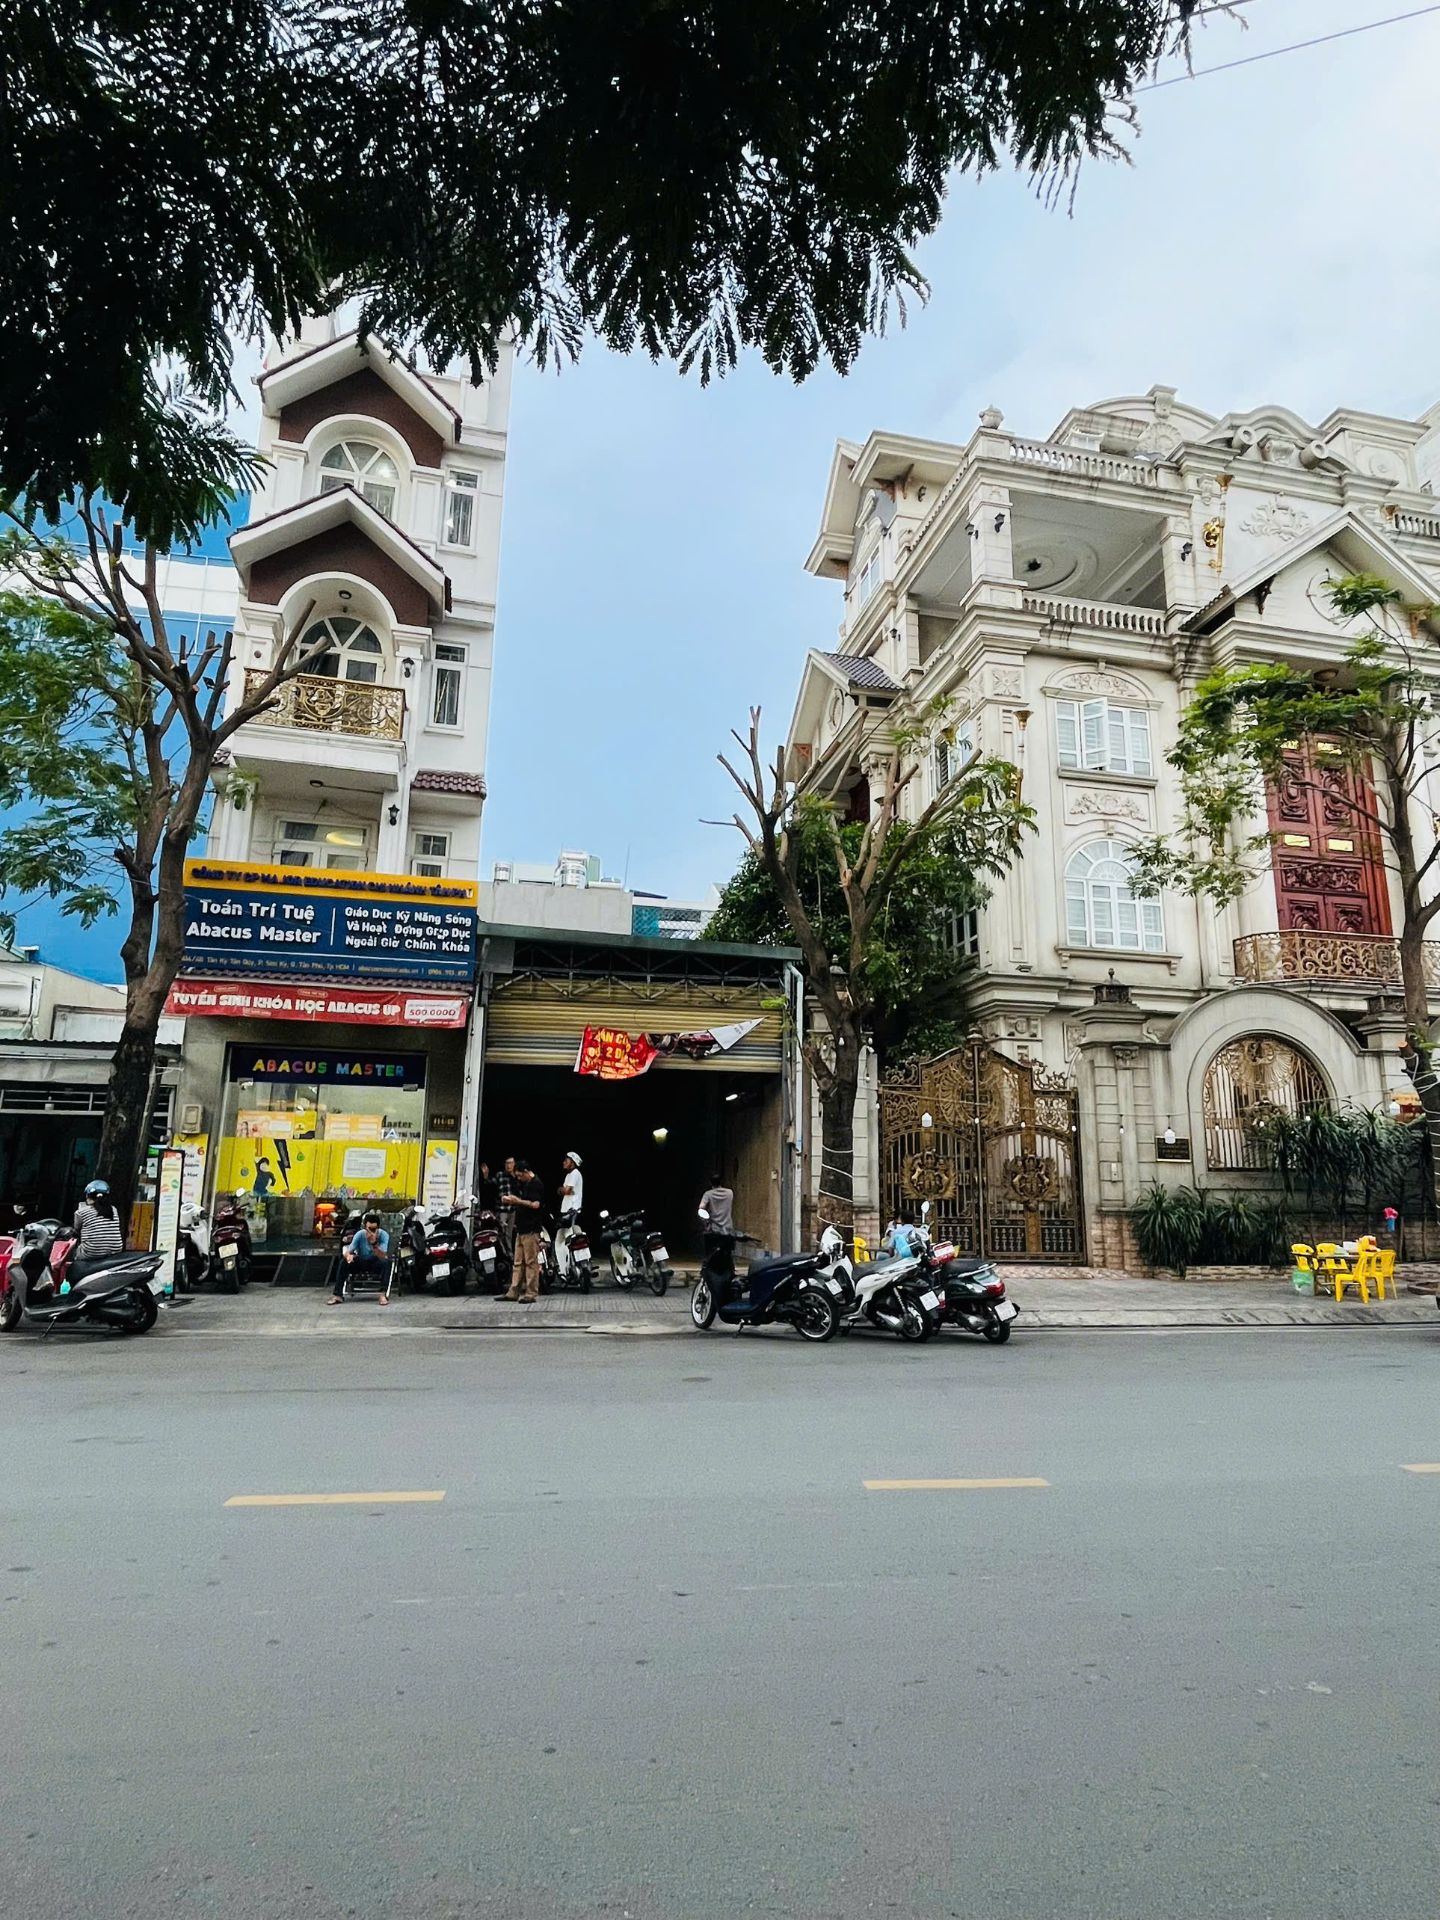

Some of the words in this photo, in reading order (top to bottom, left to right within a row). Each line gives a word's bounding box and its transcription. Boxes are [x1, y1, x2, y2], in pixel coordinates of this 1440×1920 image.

[200, 899, 243, 916] Toán
[249, 903, 276, 918] Trí
[282, 904, 315, 924] Tuệ
[415, 911, 441, 925] Năng
[186, 921, 252, 939] Abacus
[260, 925, 321, 943] Master
[405, 938, 437, 950] Chính
[219, 994, 251, 1007] SINH
[253, 994, 292, 1010] KHÓA
[295, 999, 325, 1014] HỌC
[327, 1001, 380, 1015] ABACUS
[382, 1004, 401, 1016] UP
[252, 1059, 328, 1074] ABACUS
[336, 1063, 404, 1077] MASTER
